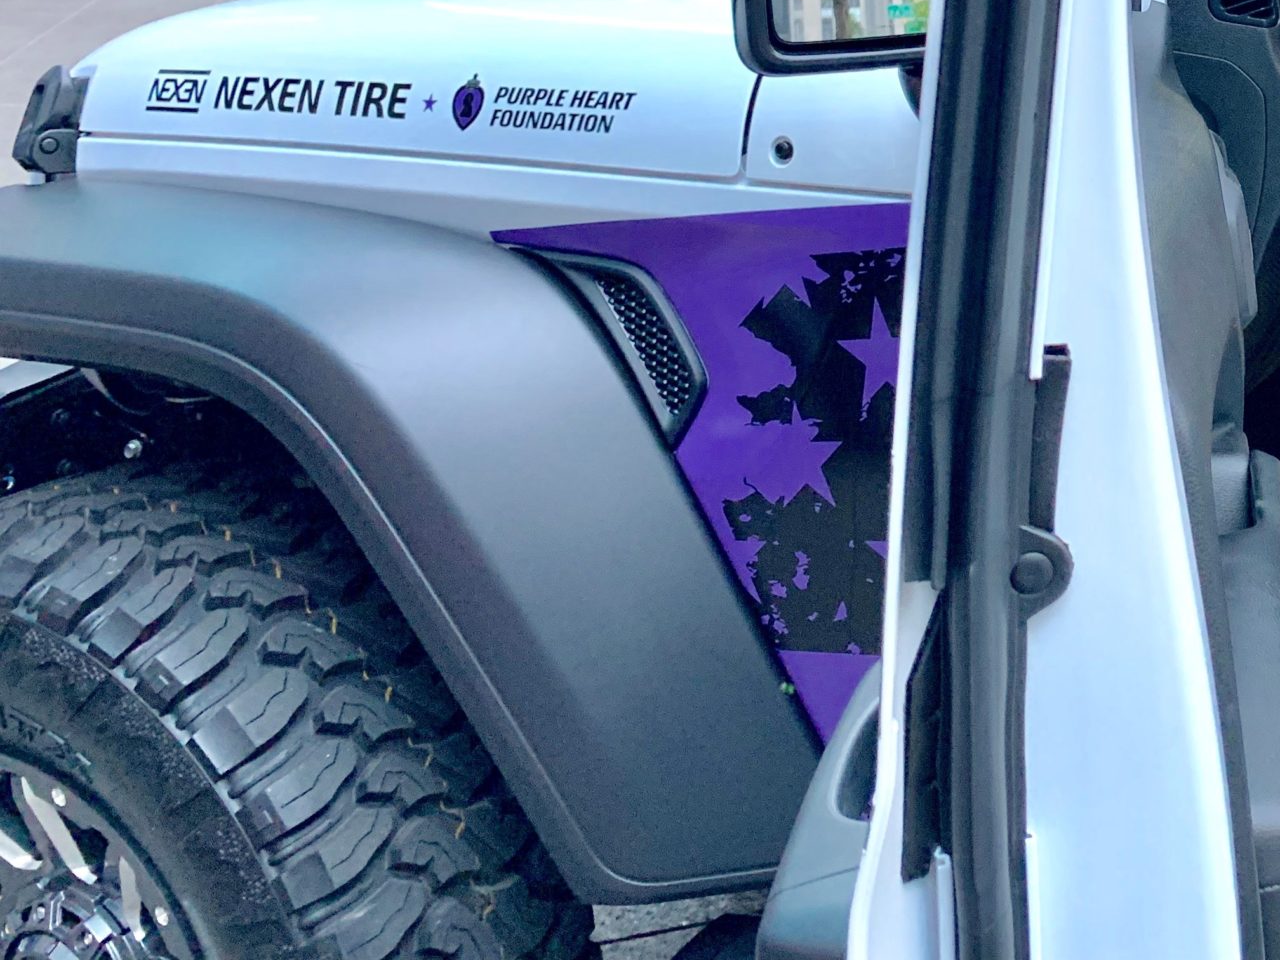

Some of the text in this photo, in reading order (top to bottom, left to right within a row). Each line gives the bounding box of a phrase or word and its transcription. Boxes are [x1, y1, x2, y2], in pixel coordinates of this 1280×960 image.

[213, 75, 413, 120] NEXEN TIRE
[493, 86, 638, 111] PURPLE HEART
[489, 109, 615, 134] FOUNDATION
